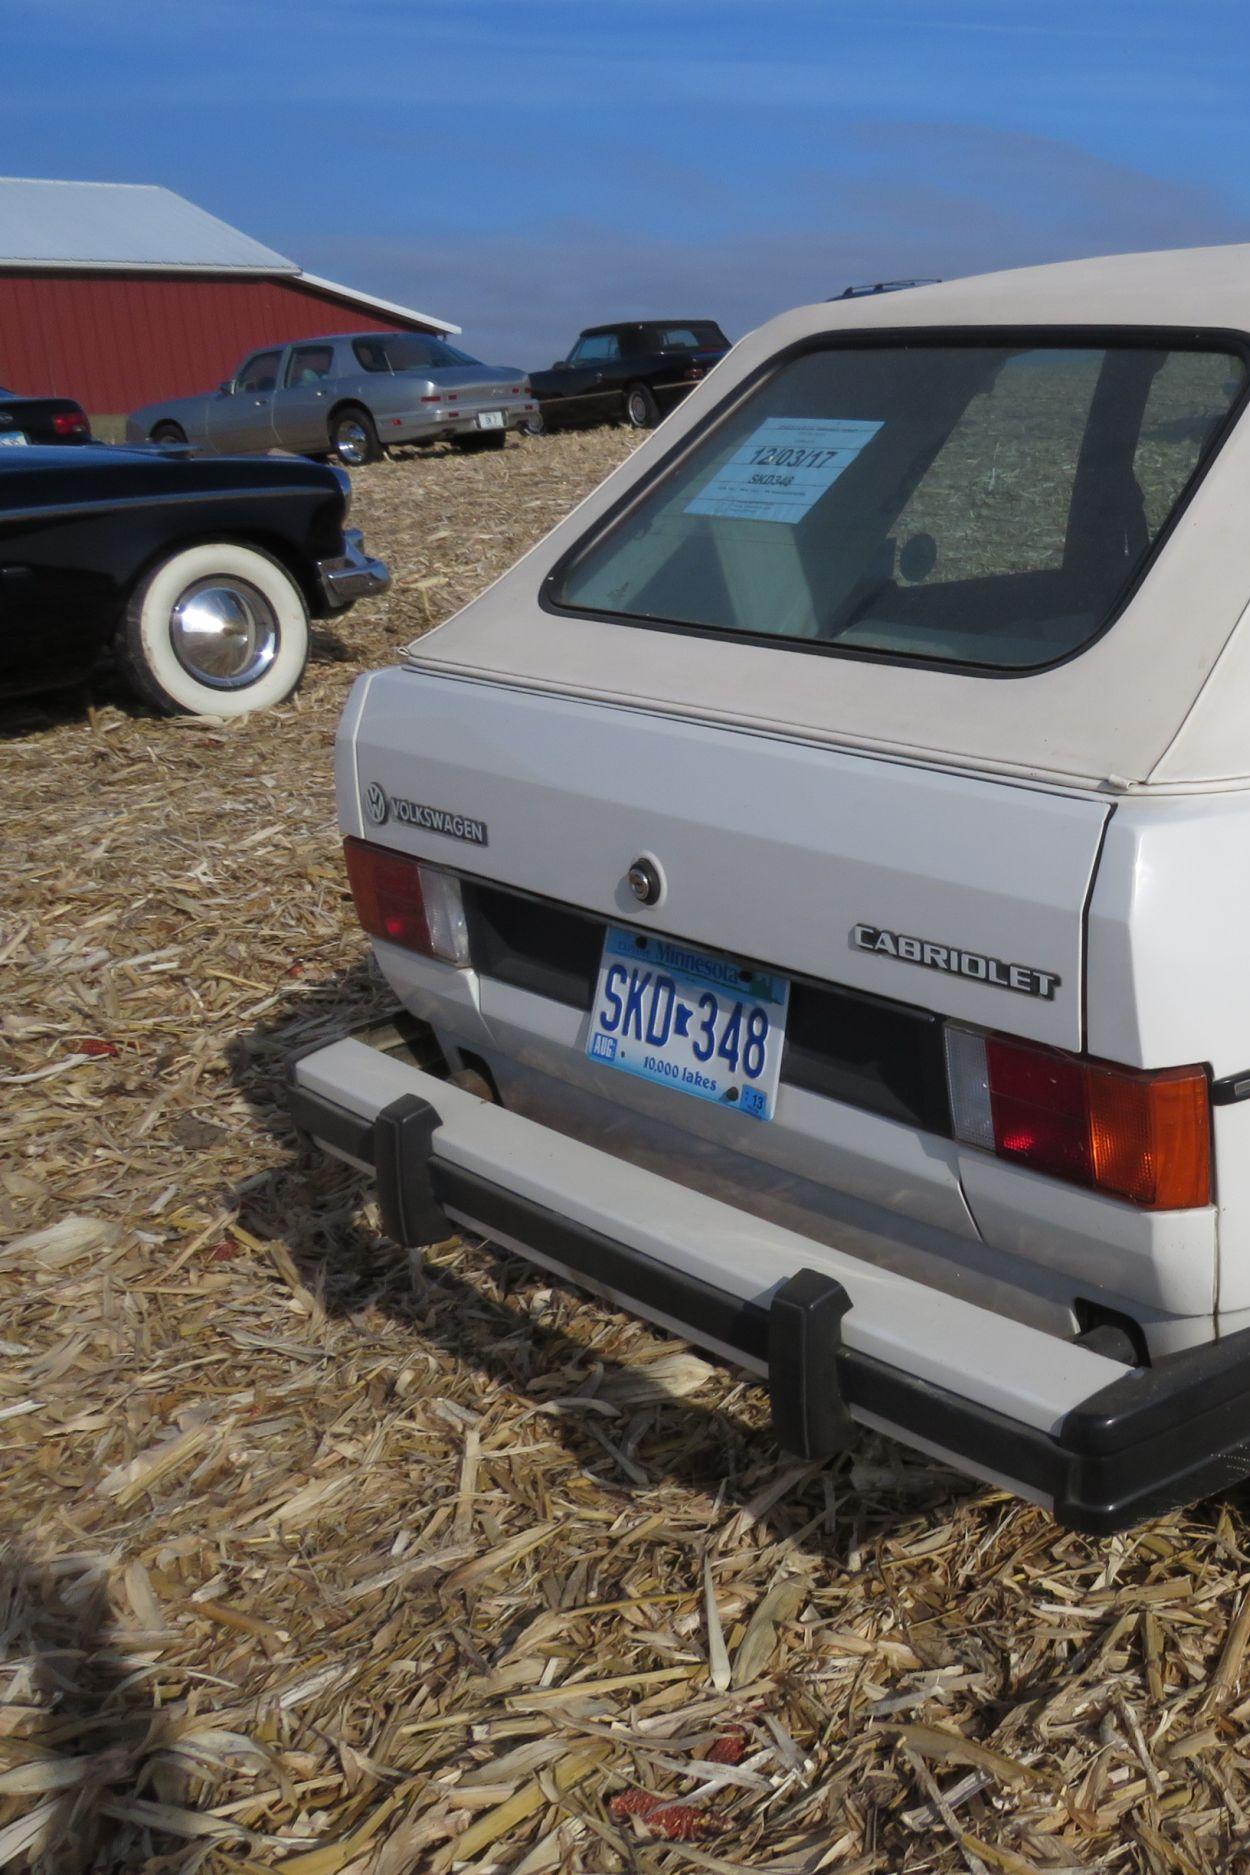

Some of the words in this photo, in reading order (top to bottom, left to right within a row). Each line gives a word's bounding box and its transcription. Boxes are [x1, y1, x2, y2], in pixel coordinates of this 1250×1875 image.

[749, 447, 838, 469] 12/03/17
[390, 799, 483, 842] VOLKSWAGEN
[657, 940, 739, 985] Minnesota
[853, 925, 1057, 997] CABRIOLET
[601, 964, 676, 1047] SKD
[692, 991, 769, 1079] 348
[593, 1035, 614, 1058] AUG
[643, 1056, 679, 1078] 10,000
[682, 1067, 717, 1091] lakes
[752, 1094, 764, 1110] 13
